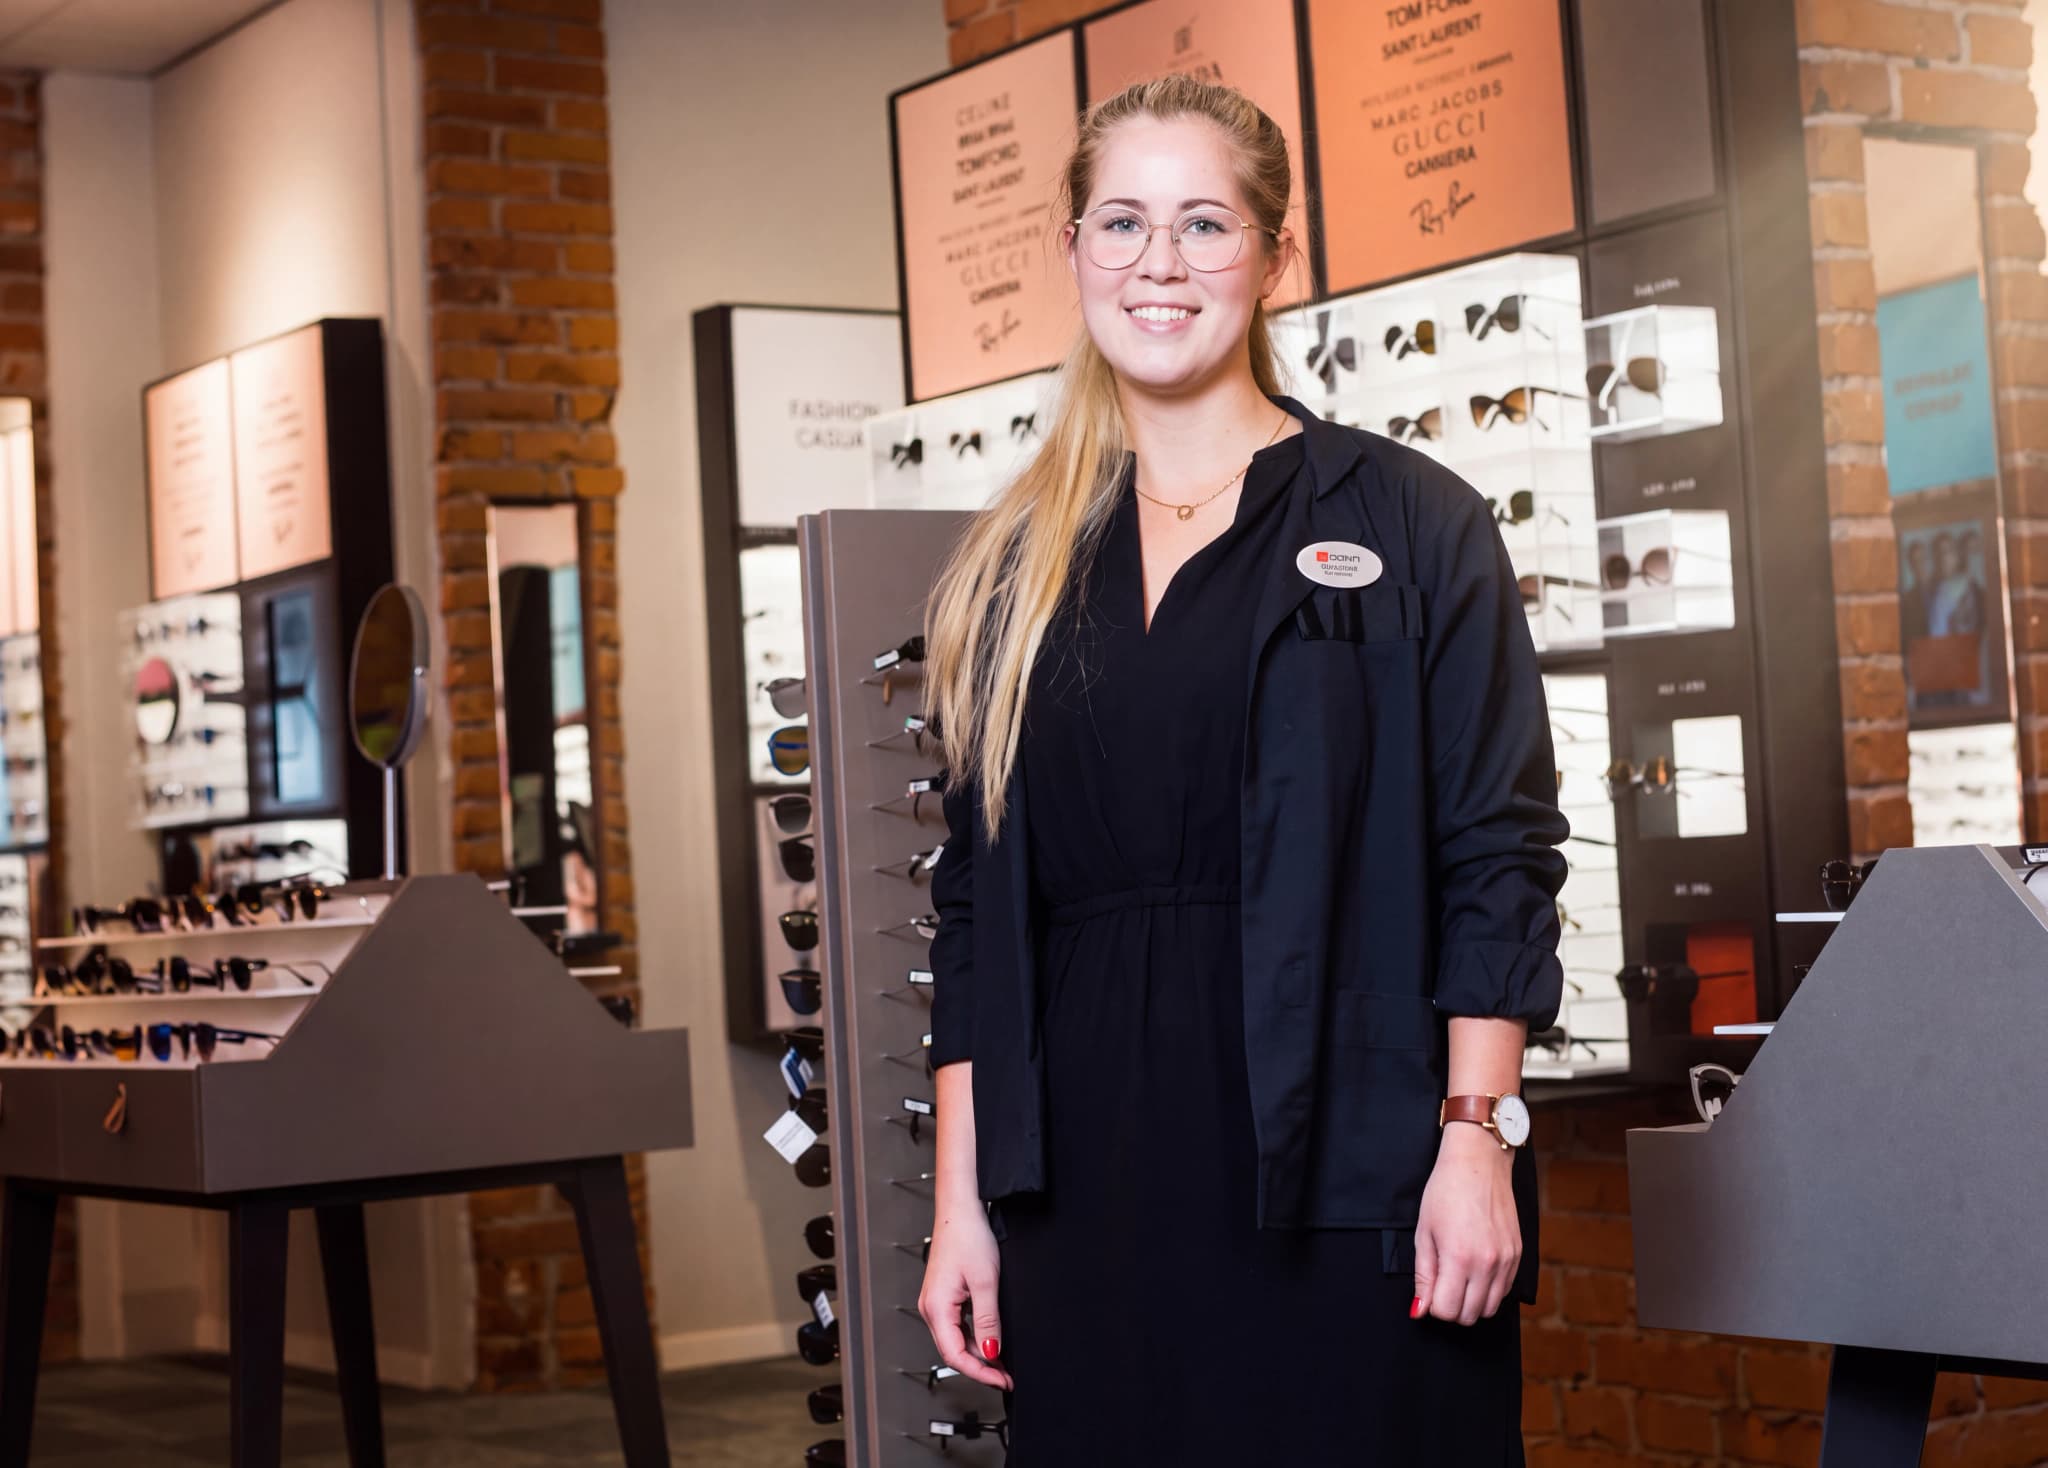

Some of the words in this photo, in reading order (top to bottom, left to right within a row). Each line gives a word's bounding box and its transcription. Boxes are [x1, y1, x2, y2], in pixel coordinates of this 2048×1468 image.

[1382, 34, 1417, 61] SAINT
[1419, 12, 1482, 48] LAURENT
[1386, 1, 1422, 29] TOM
[1371, 103, 1421, 131] MARC
[1429, 79, 1503, 116] JACOBS
[1392, 109, 1486, 157] GUCCI
[795, 427, 864, 449] CASUA
